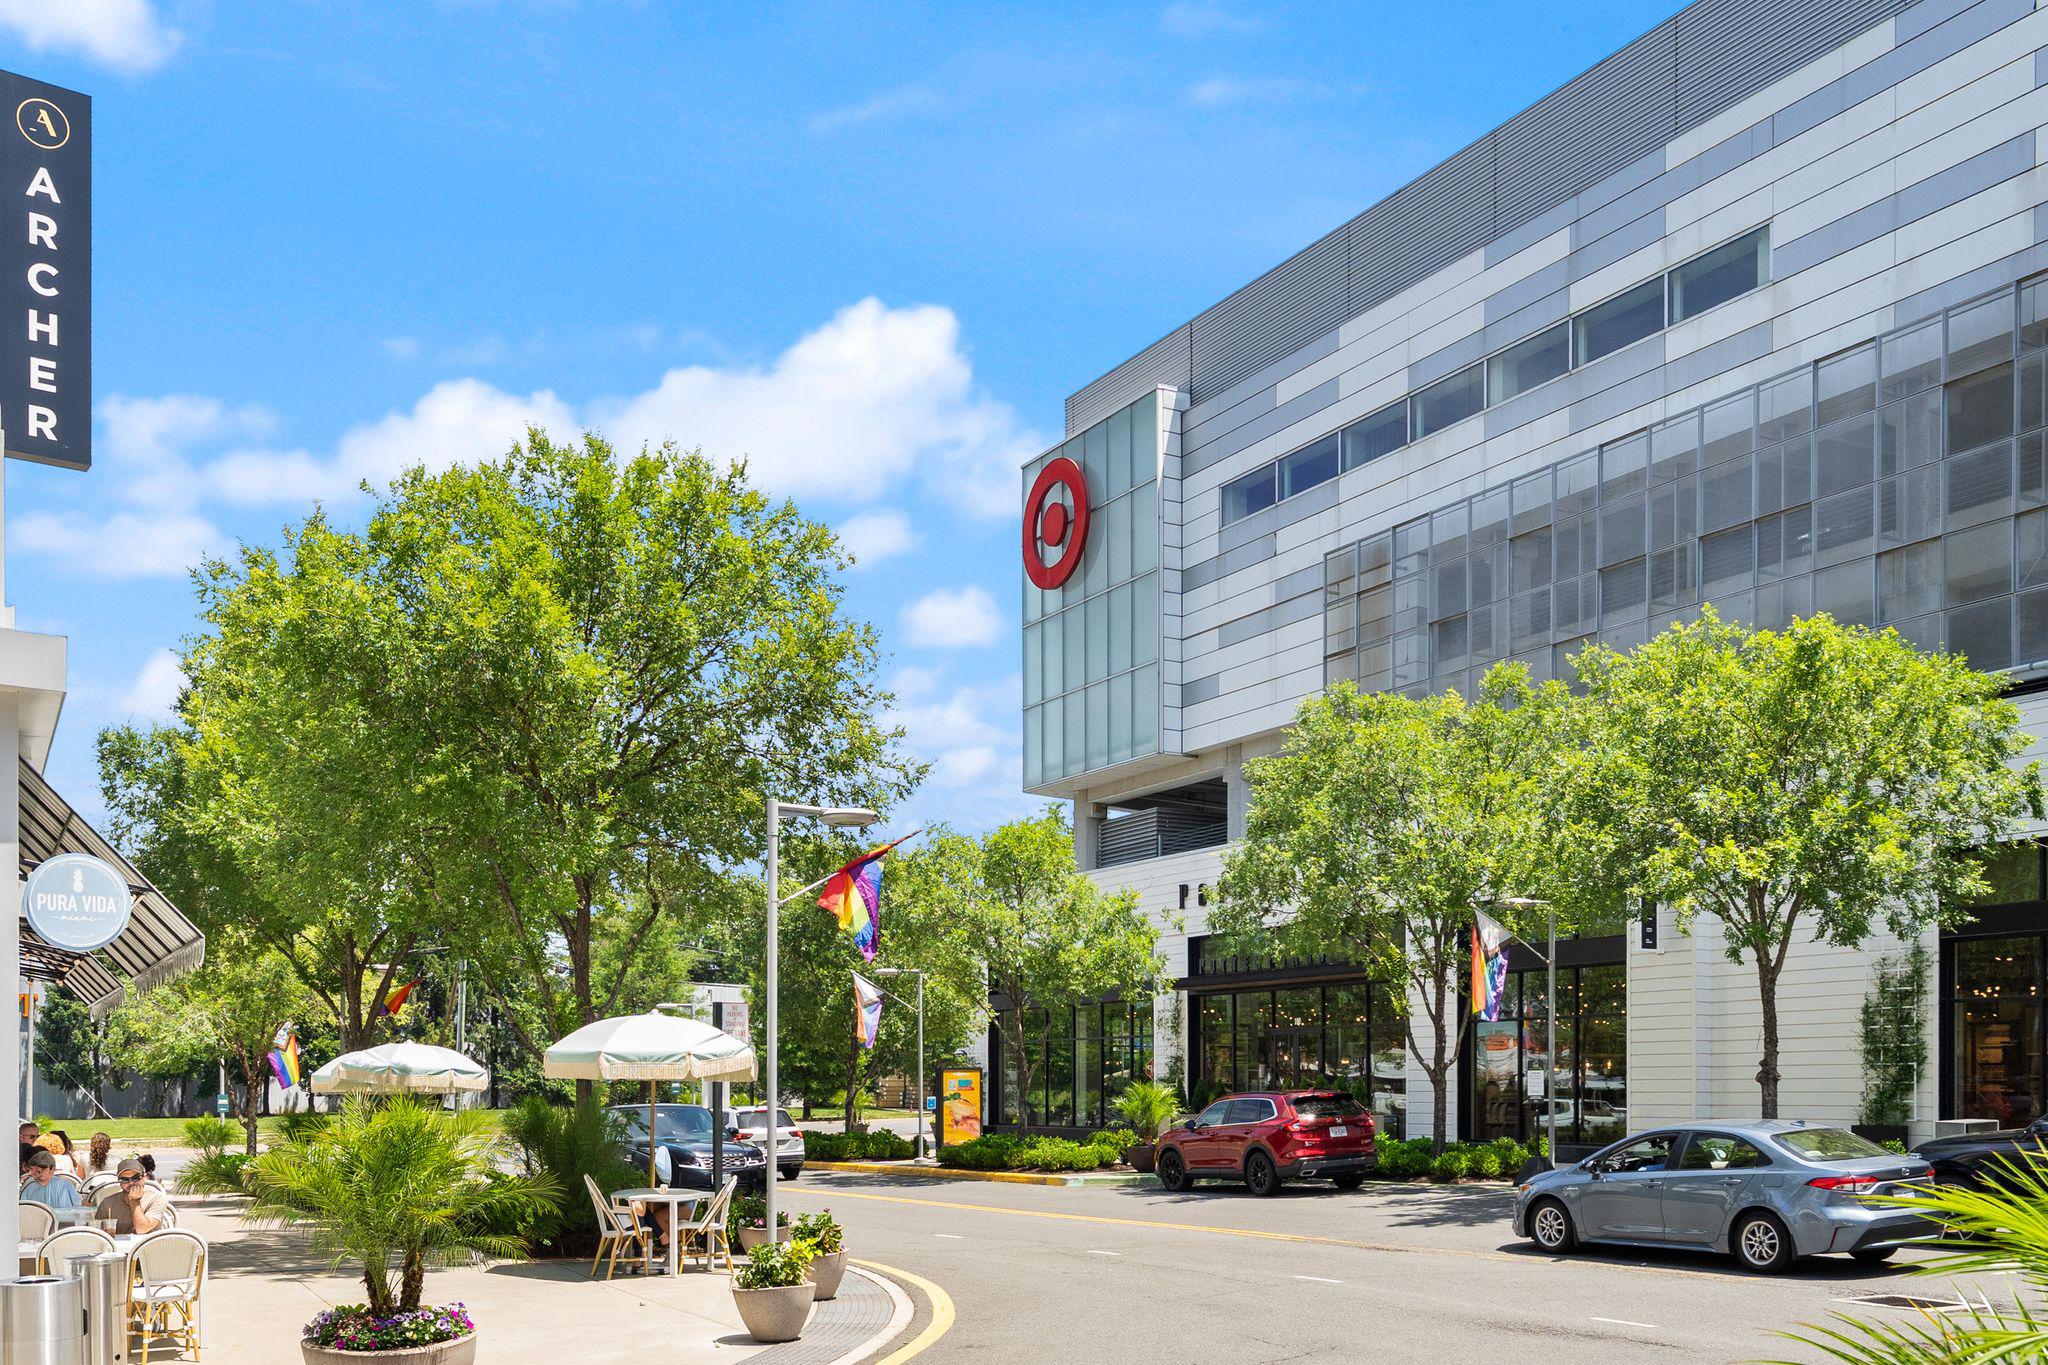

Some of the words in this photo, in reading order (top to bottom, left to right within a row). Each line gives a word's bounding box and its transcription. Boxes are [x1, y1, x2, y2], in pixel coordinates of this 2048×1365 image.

[25, 166, 62, 442] ARCHER
[37, 893, 78, 912] PURA
[82, 895, 117, 913] VIDA
